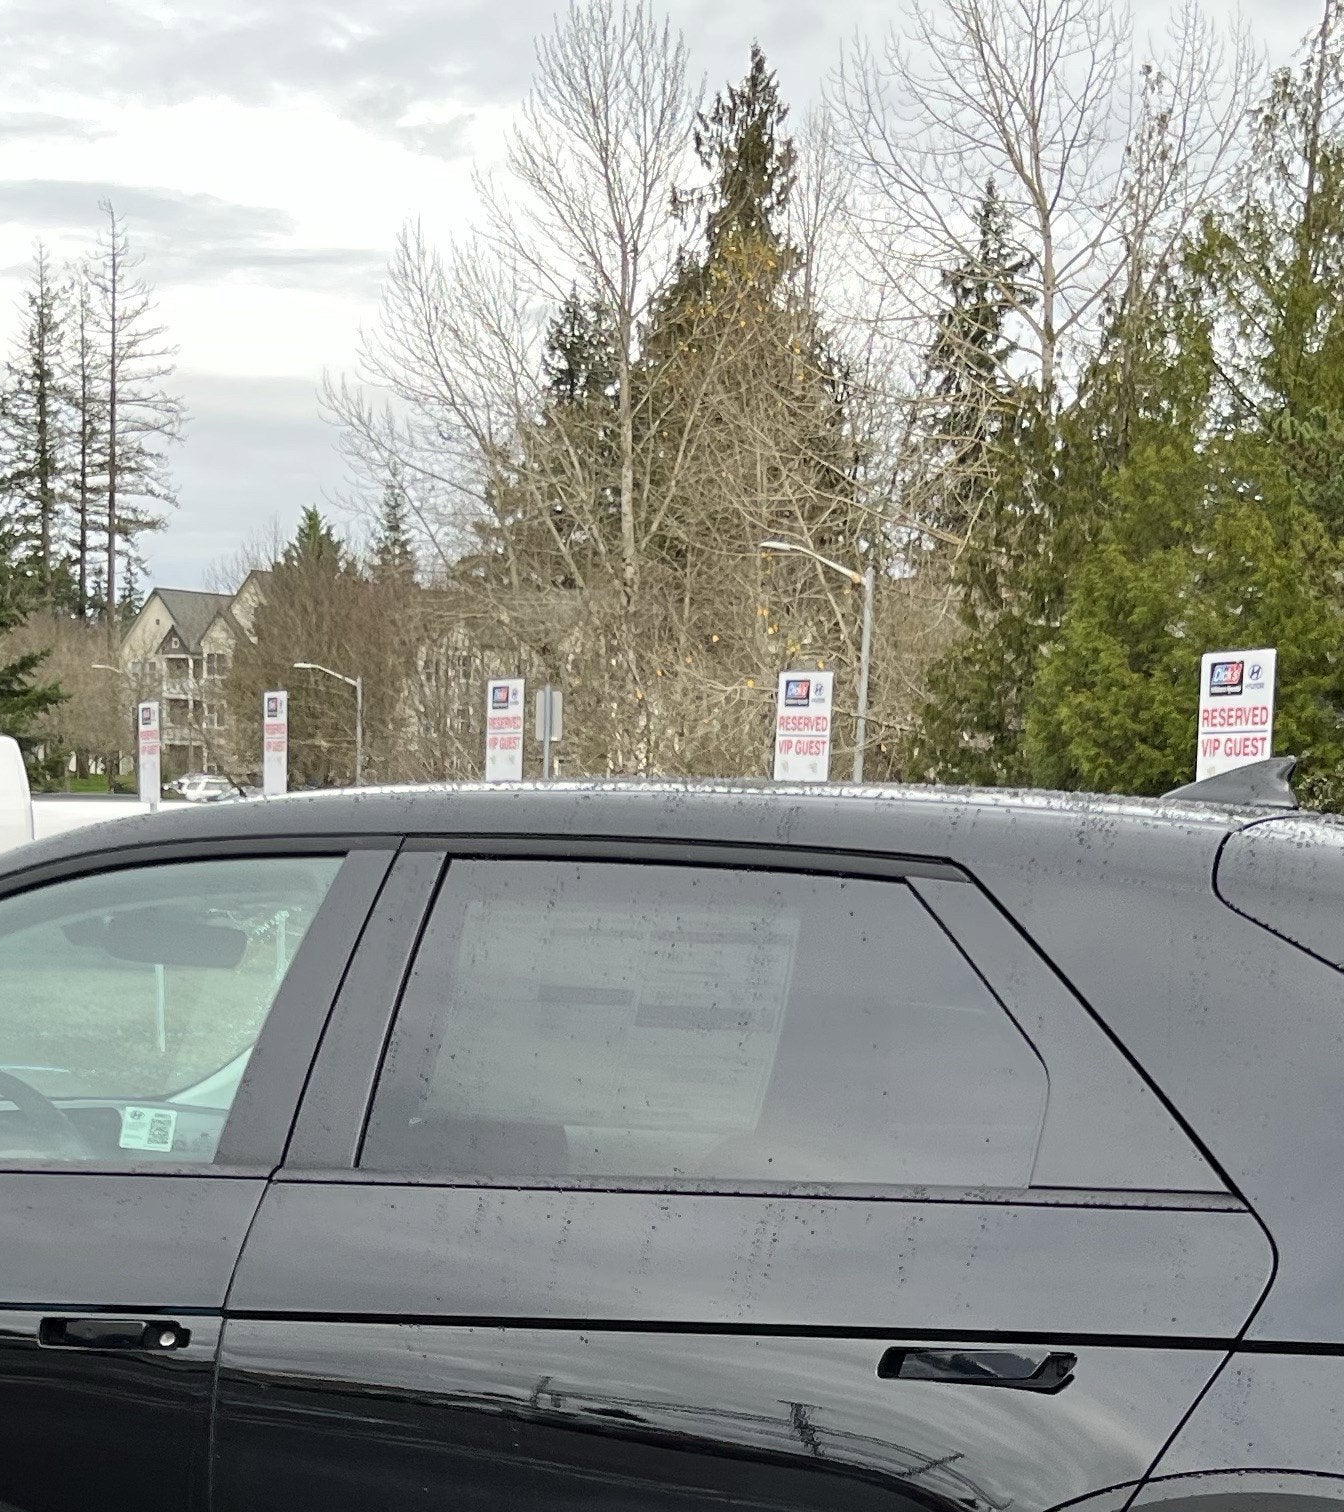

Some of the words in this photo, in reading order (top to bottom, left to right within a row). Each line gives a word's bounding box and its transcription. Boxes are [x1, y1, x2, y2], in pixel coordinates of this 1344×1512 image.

[778, 716, 828, 732] RESERVED
[1202, 706, 1269, 727] RESERVED
[778, 739, 792, 755] VIP
[794, 739, 827, 756] GUEST
[1202, 738, 1221, 757] VIP
[1223, 736, 1267, 757] GUEST
